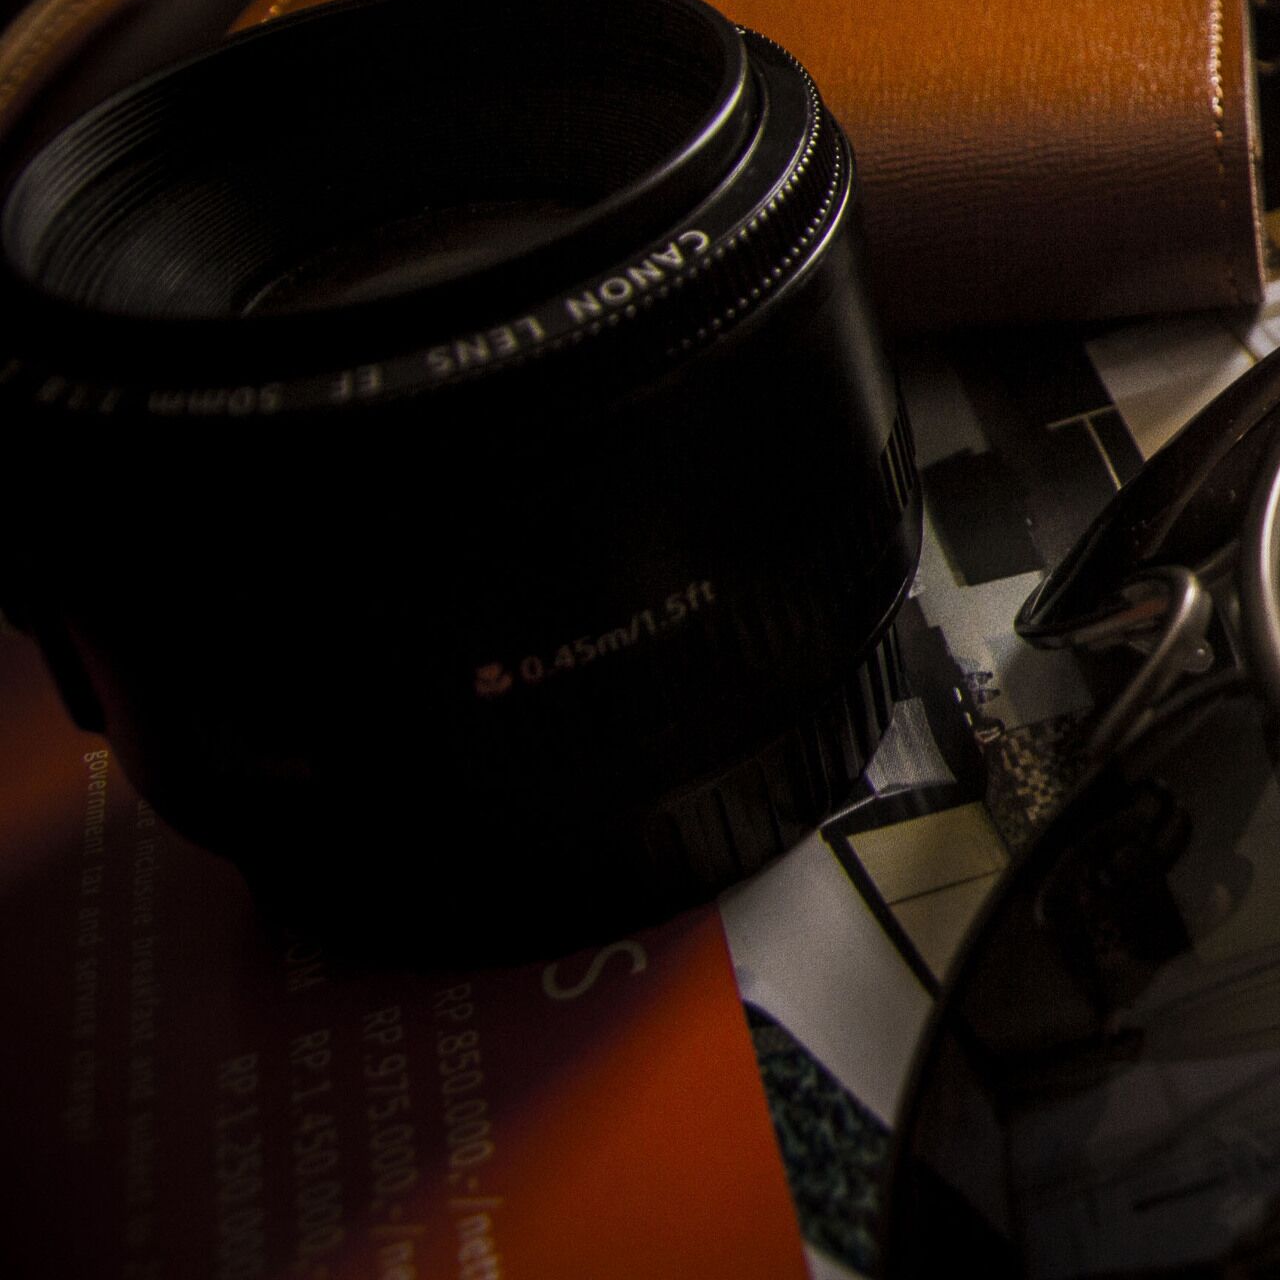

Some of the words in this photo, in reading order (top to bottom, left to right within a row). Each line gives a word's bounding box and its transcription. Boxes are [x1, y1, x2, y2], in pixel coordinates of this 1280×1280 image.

[564, 228, 712, 322] CANON
[332, 362, 384, 405] EF
[425, 315, 546, 374] LENS
[518, 578, 717, 688] 0.45m/1.5ft
[83, 748, 112, 857] government
